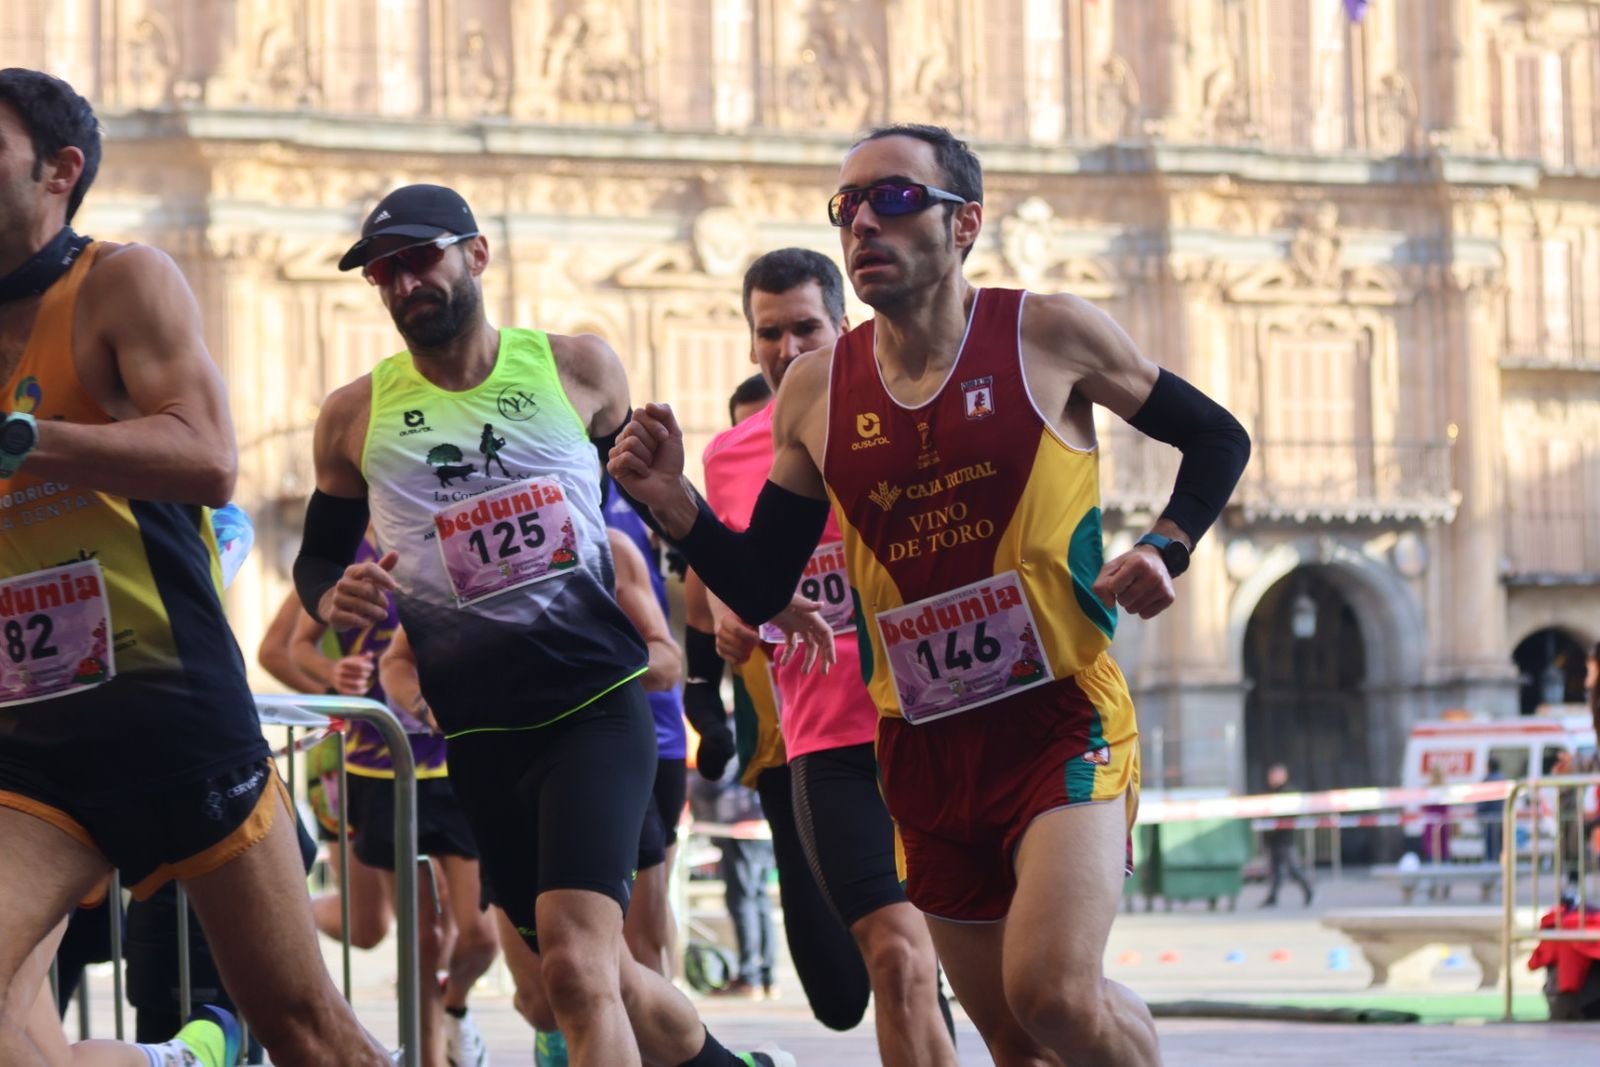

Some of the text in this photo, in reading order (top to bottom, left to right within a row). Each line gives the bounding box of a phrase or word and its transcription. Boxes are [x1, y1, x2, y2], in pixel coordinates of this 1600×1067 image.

[501, 391, 537, 413] NYX
[434, 490, 448, 502] La
[906, 461, 997, 500] CAJA RURAL
[434, 484, 563, 540] bedunia
[908, 501, 967, 533] VINO
[468, 512, 546, 564] 125
[889, 519, 994, 562] DE TORO
[801, 573, 845, 604] 90
[878, 584, 1023, 647] bedunia
[5, 614, 58, 663] 82
[916, 621, 1000, 679] 146
